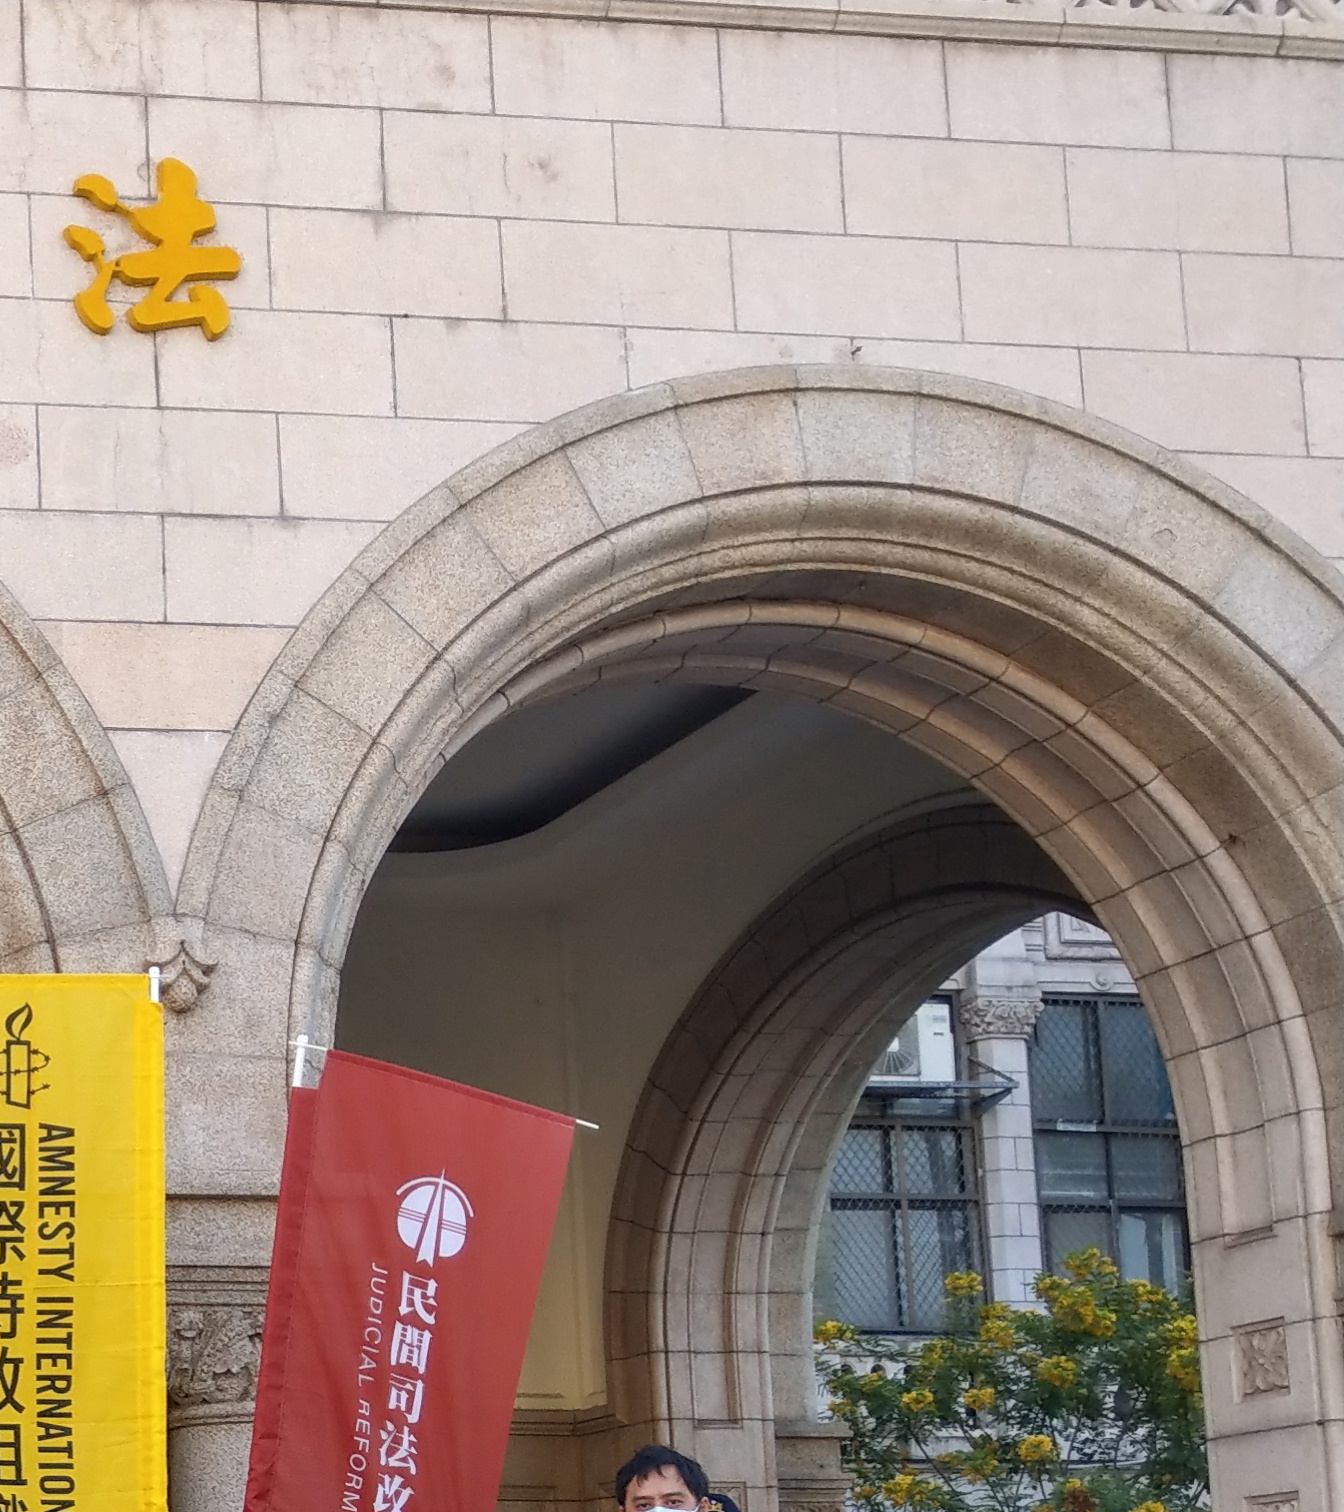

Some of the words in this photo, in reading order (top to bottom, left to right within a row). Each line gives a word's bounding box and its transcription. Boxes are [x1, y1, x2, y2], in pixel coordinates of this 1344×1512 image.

[62, 157, 241, 342] 法
[37, 1122, 77, 1283] AMNESTY
[357, 1262, 389, 1387] JUDICIAL
[341, 1399, 371, 1512] REFORM
